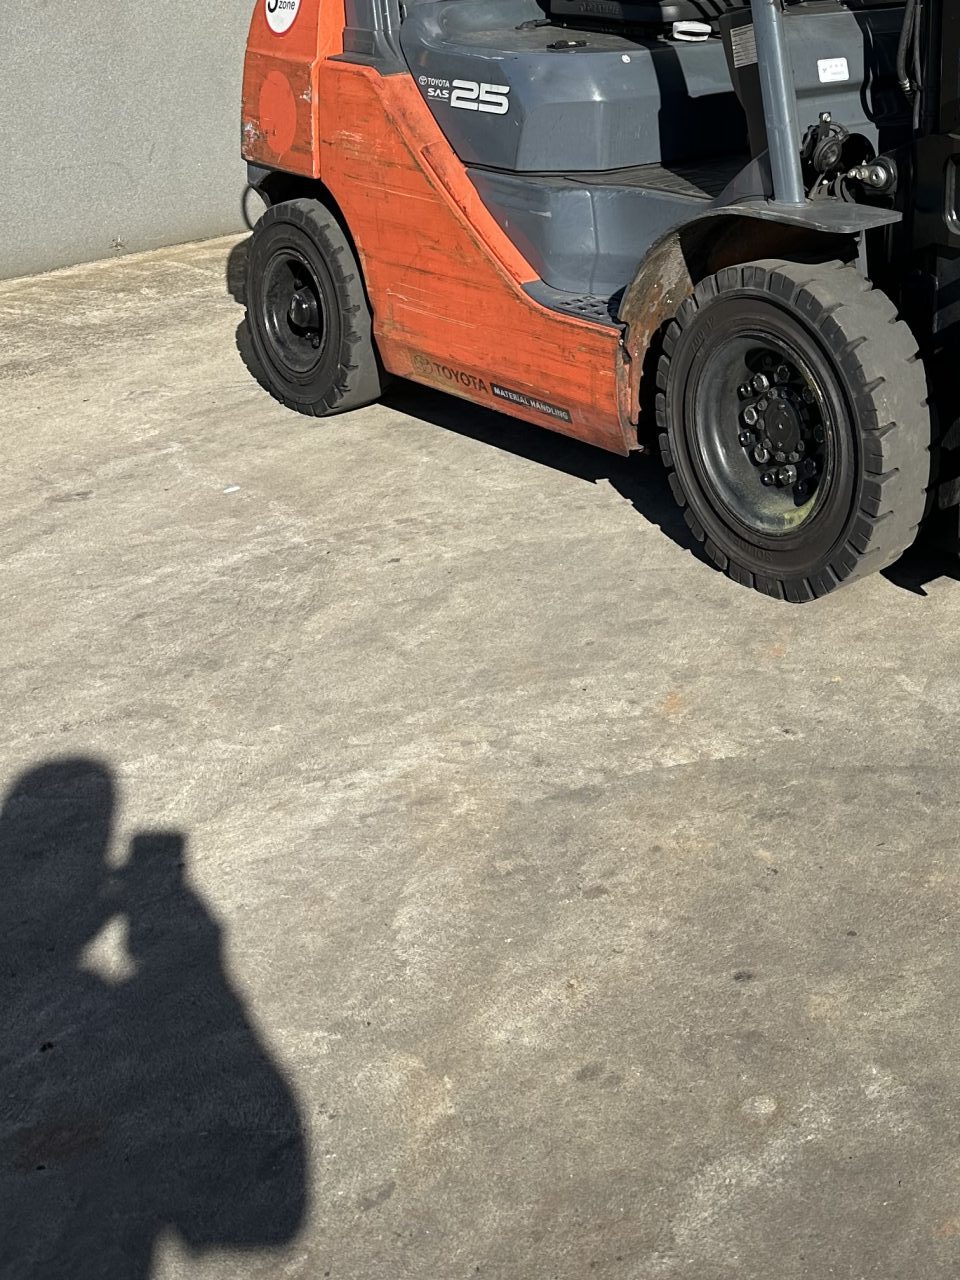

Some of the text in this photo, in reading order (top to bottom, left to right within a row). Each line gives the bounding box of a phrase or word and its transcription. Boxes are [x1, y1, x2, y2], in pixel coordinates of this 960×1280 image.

[278, 0, 296, 10] zone
[427, 77, 450, 88] TOYOTA
[427, 87, 450, 98] SAS
[450, 79, 510, 115] 25
[434, 362, 569, 420] TOYOTA MATERIAL HANDLING
